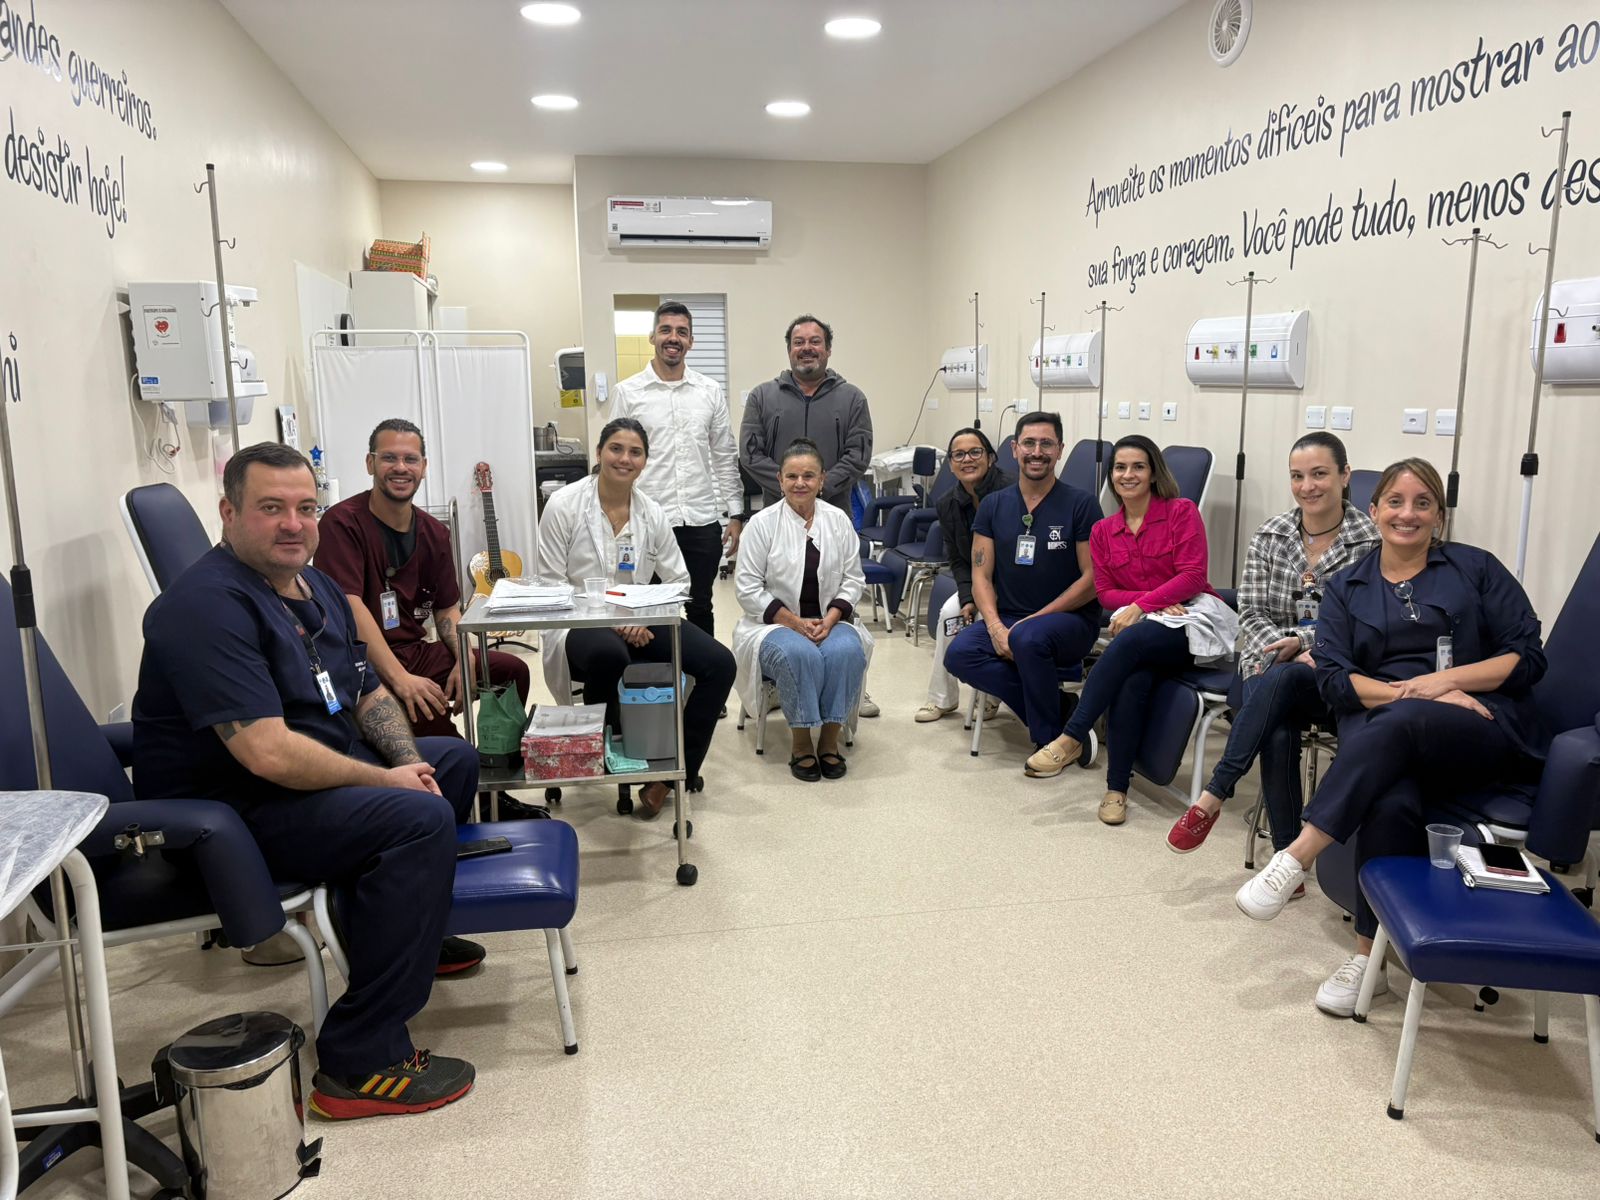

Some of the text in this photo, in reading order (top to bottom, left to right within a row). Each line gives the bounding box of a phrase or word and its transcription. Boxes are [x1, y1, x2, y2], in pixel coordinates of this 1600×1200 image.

[68, 50, 157, 141] guerreiros.
[1085, 163, 1145, 229] Aproveite
[1149, 165, 1165, 194] os
[1169, 128, 1252, 189] momentos
[1256, 94, 1336, 160] difíceis
[1339, 82, 1401, 158] para
[1410, 36, 1545, 117] mostrar
[4, 106, 128, 239] desistir hoje!
[1087, 260, 1109, 288] sua
[1112, 245, 1147, 294] força
[1151, 246, 1159, 275] e
[1163, 233, 1235, 275] coragem.
[1242, 208, 1288, 258] Você
[1289, 192, 1344, 271] pode
[1351, 178, 1416, 241] tudo,
[1427, 171, 1530, 230] menos
